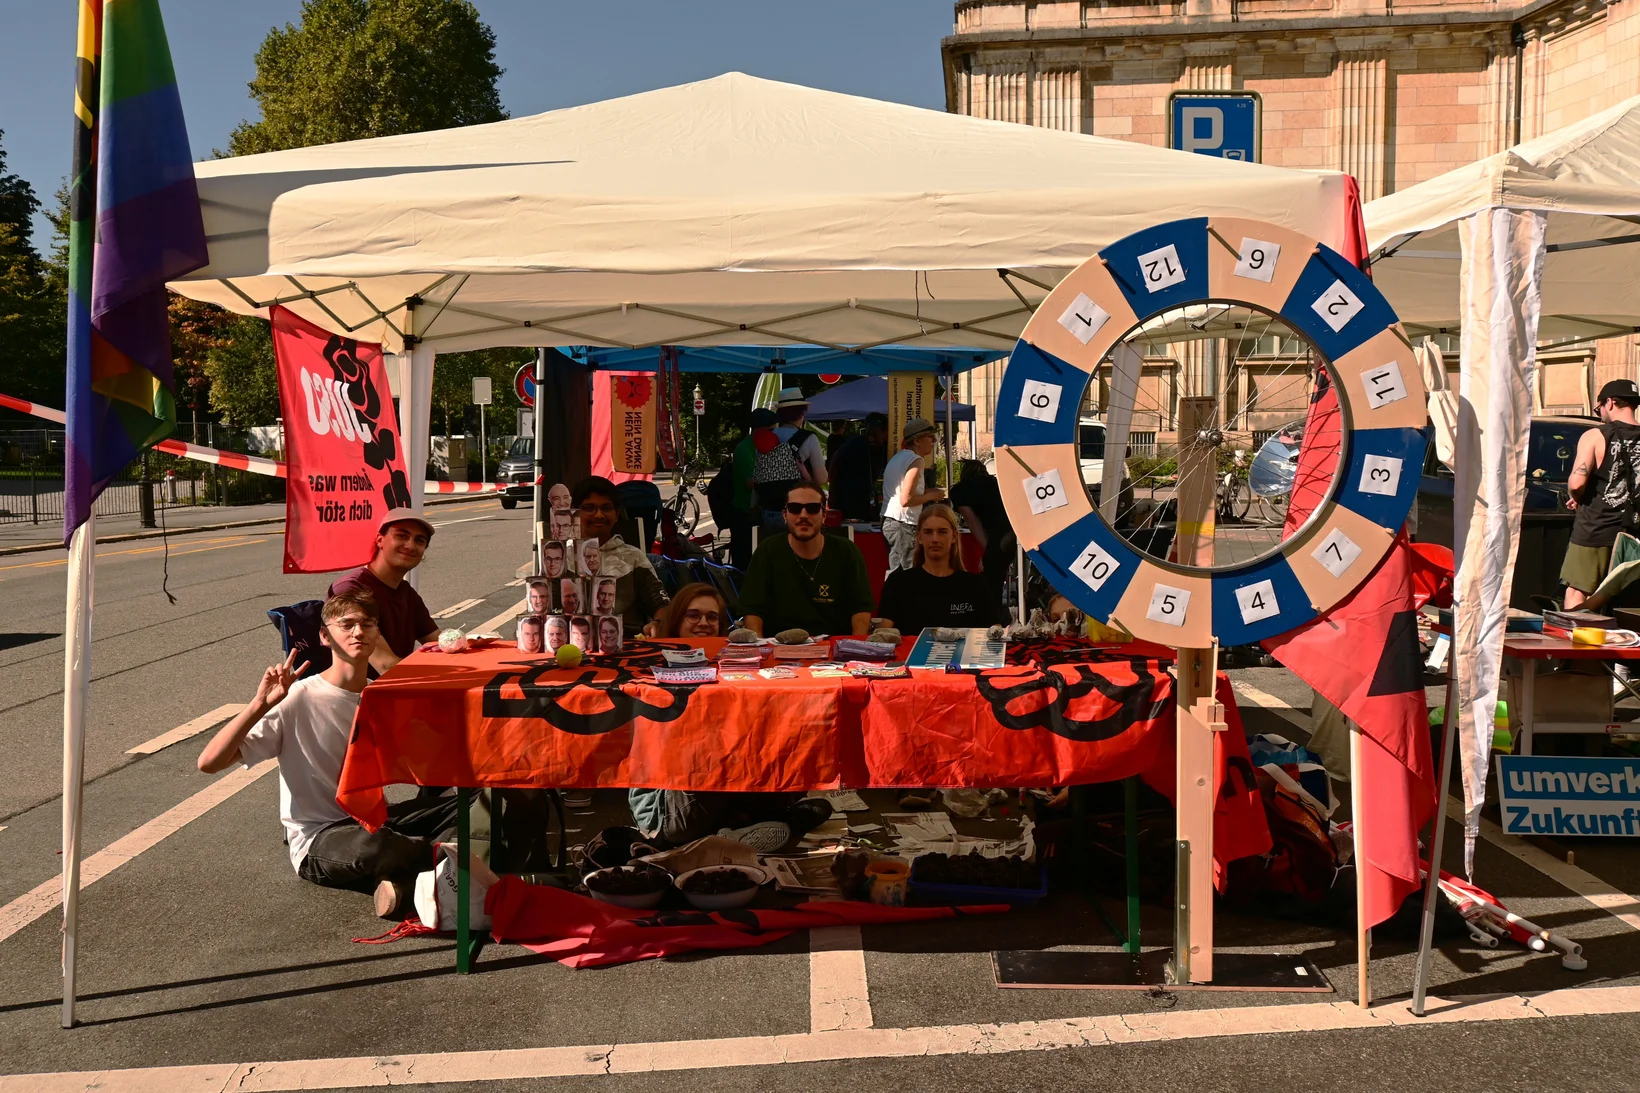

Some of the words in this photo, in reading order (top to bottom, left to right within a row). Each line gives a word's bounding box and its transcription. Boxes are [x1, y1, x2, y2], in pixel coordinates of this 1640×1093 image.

[1182, 107, 1224, 153] P
[1249, 248, 1265, 270] 6
[1144, 257, 1177, 283] 12
[1327, 294, 1349, 316] 2
[1075, 312, 1092, 327] 1
[1370, 372, 1395, 400] 11
[1030, 393, 1050, 409] 9
[1370, 468, 1391, 483] 3
[1035, 484, 1056, 500] 8
[1325, 542, 1343, 562] 7
[1083, 553, 1109, 580] 10
[1161, 594, 1177, 615] 5
[1251, 591, 1266, 610] 4
[1509, 766, 1640, 794] umverk
